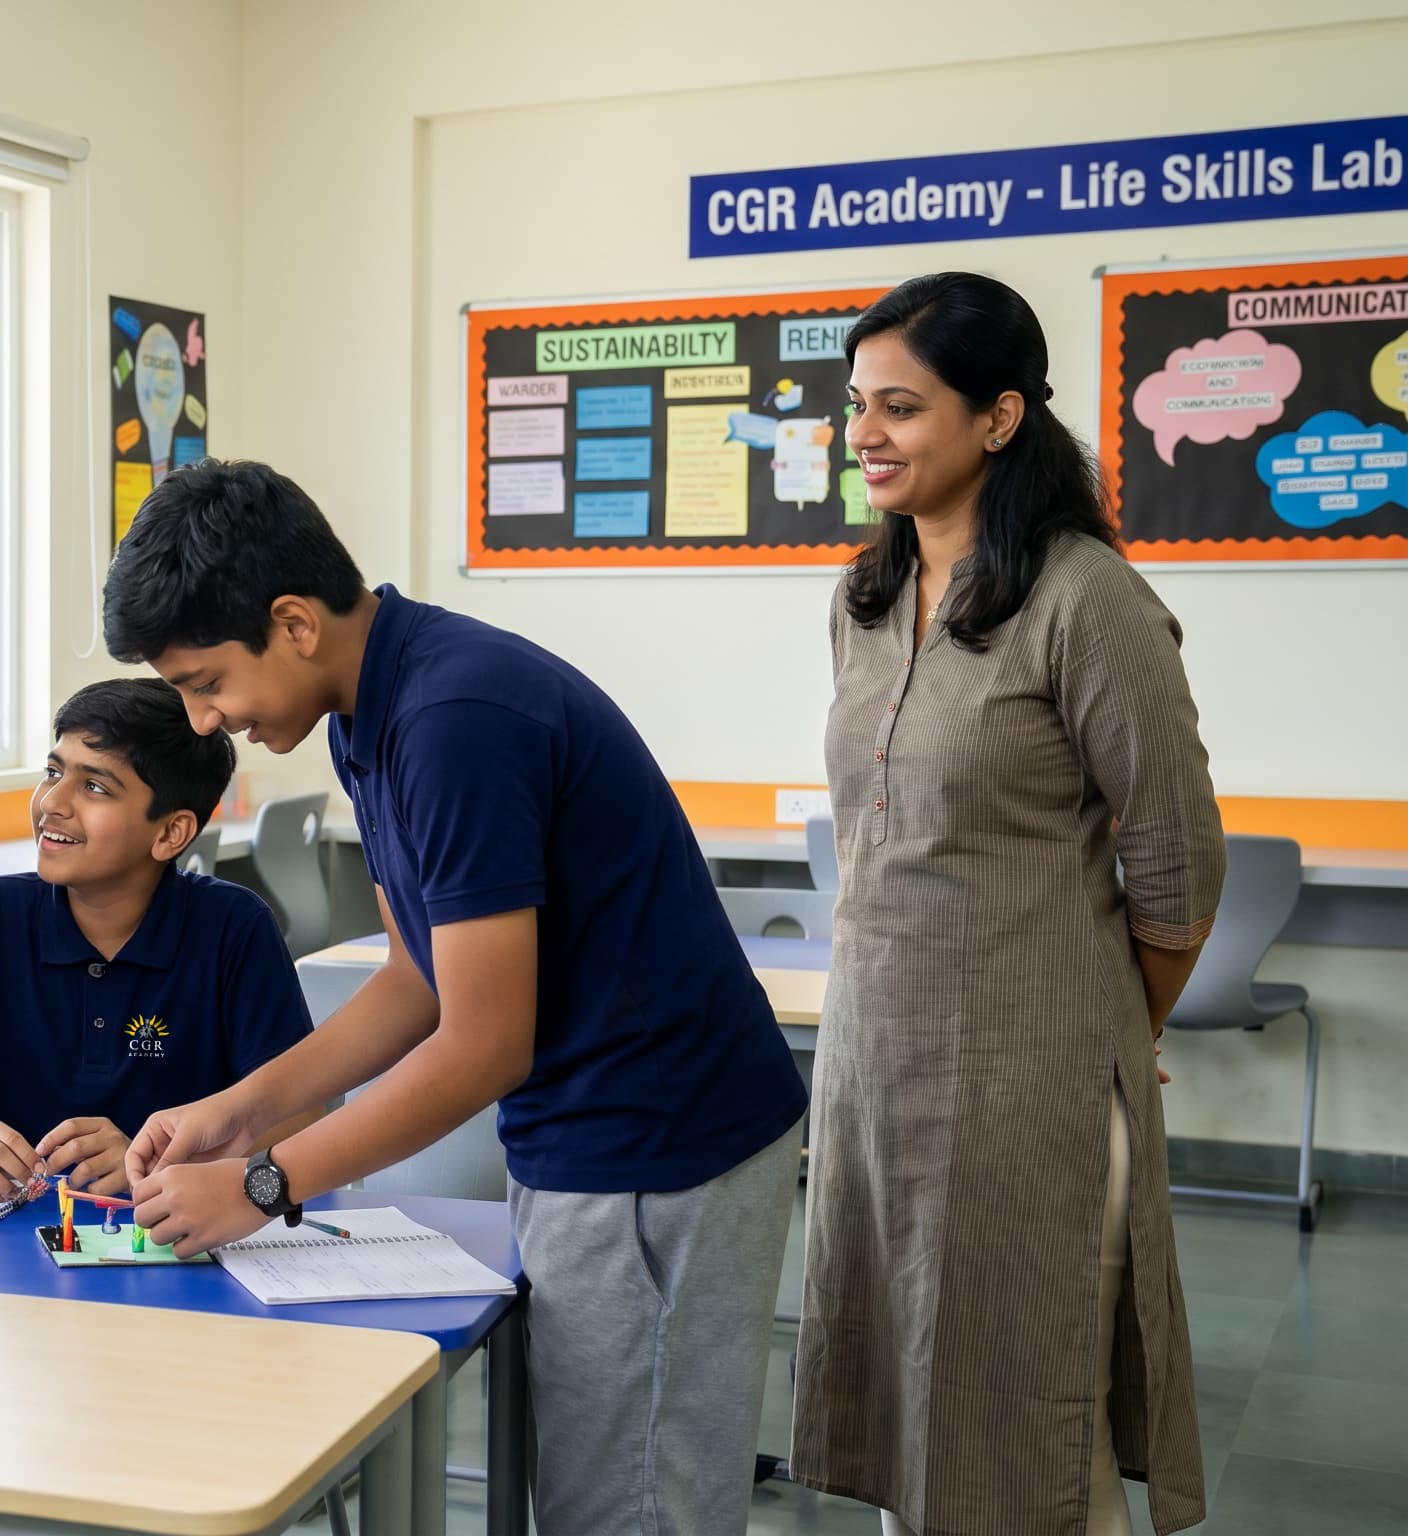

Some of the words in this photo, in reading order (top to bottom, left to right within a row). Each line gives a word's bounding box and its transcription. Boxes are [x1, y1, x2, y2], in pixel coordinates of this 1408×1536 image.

[707, 186, 796, 237] CGR
[809, 176, 1013, 226] Academy
[1026, 188, 1044, 200] -
[1059, 160, 1146, 211] Life
[1161, 149, 1294, 204] Skills
[1312, 138, 1404, 192] Lab
[1234, 289, 1408, 323] COMMUNICAT
[542, 330, 729, 364] SUSTAINABILTY
[129, 1039, 165, 1051] CGR
